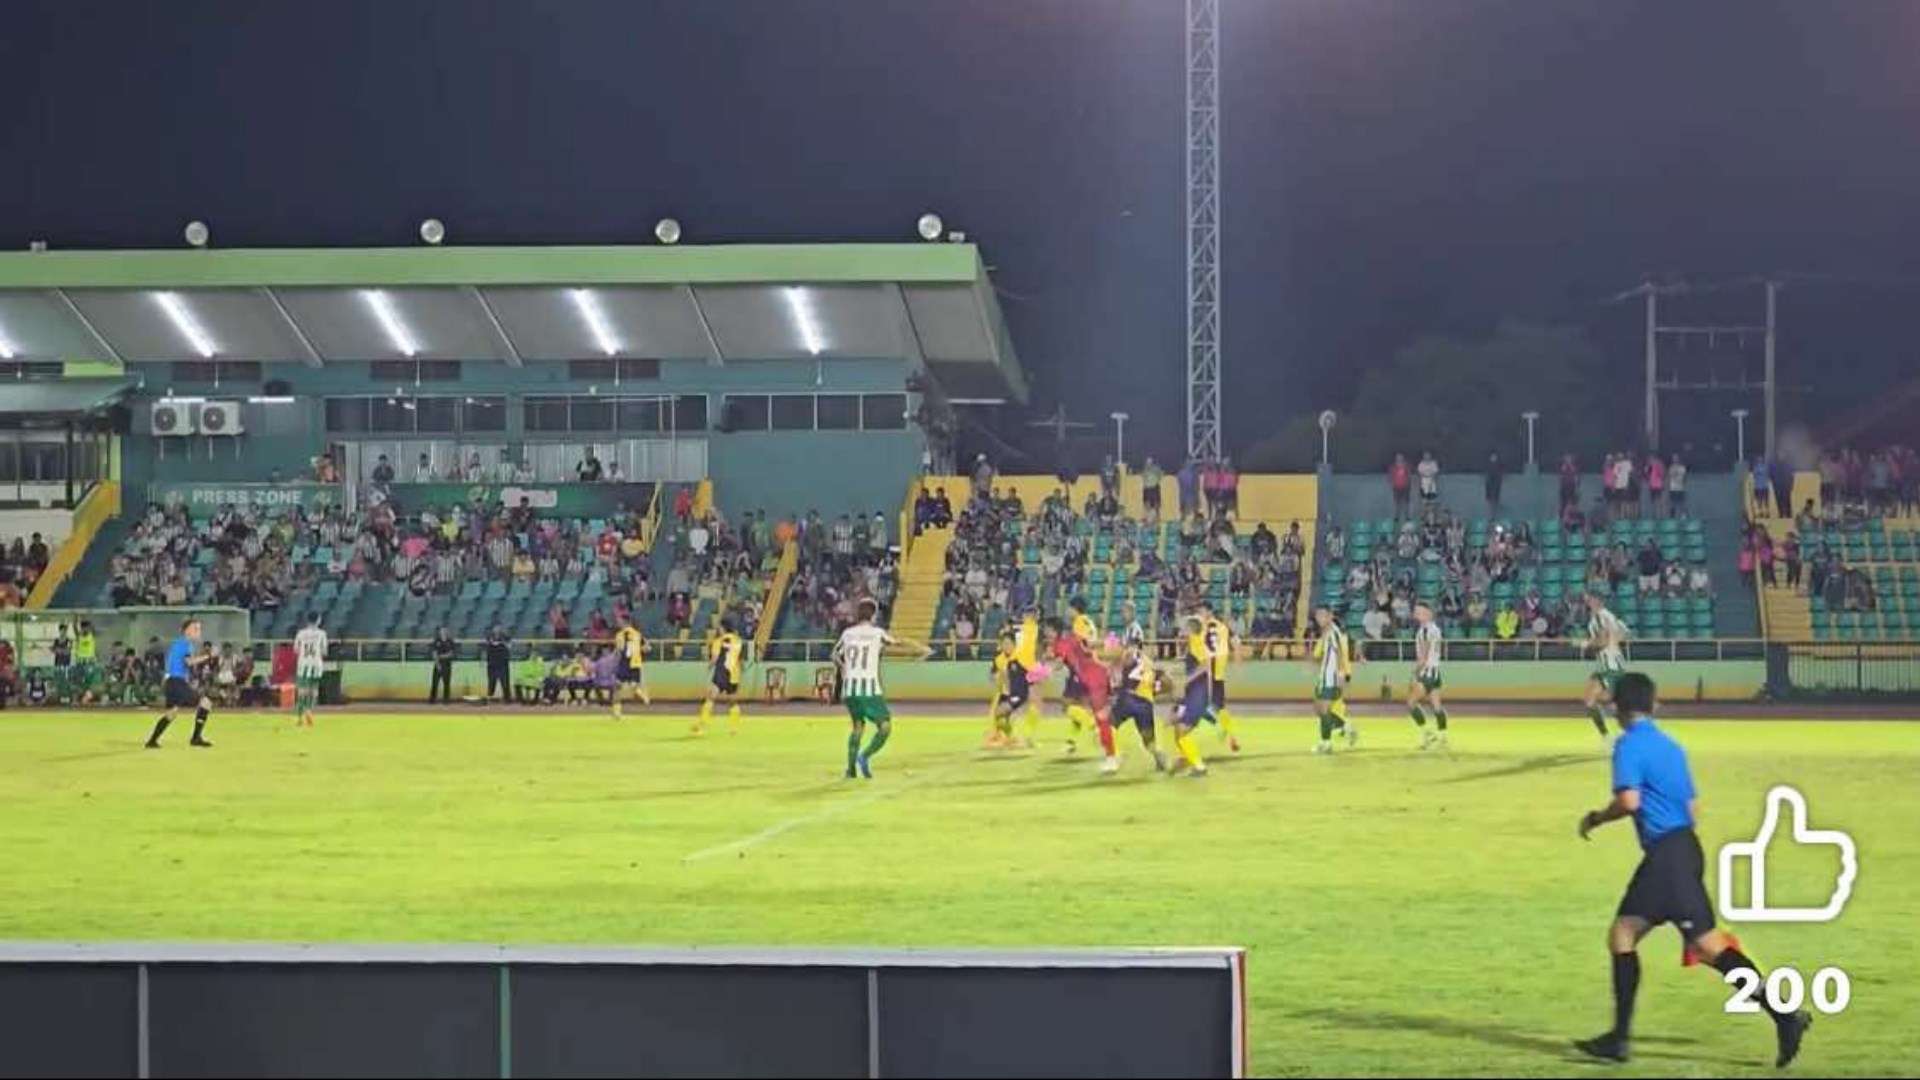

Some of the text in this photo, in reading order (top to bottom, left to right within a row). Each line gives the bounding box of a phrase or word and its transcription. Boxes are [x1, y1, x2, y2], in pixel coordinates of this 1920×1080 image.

[192, 489, 303, 505] PRESS ZONE
[846, 644, 869, 669] 91
